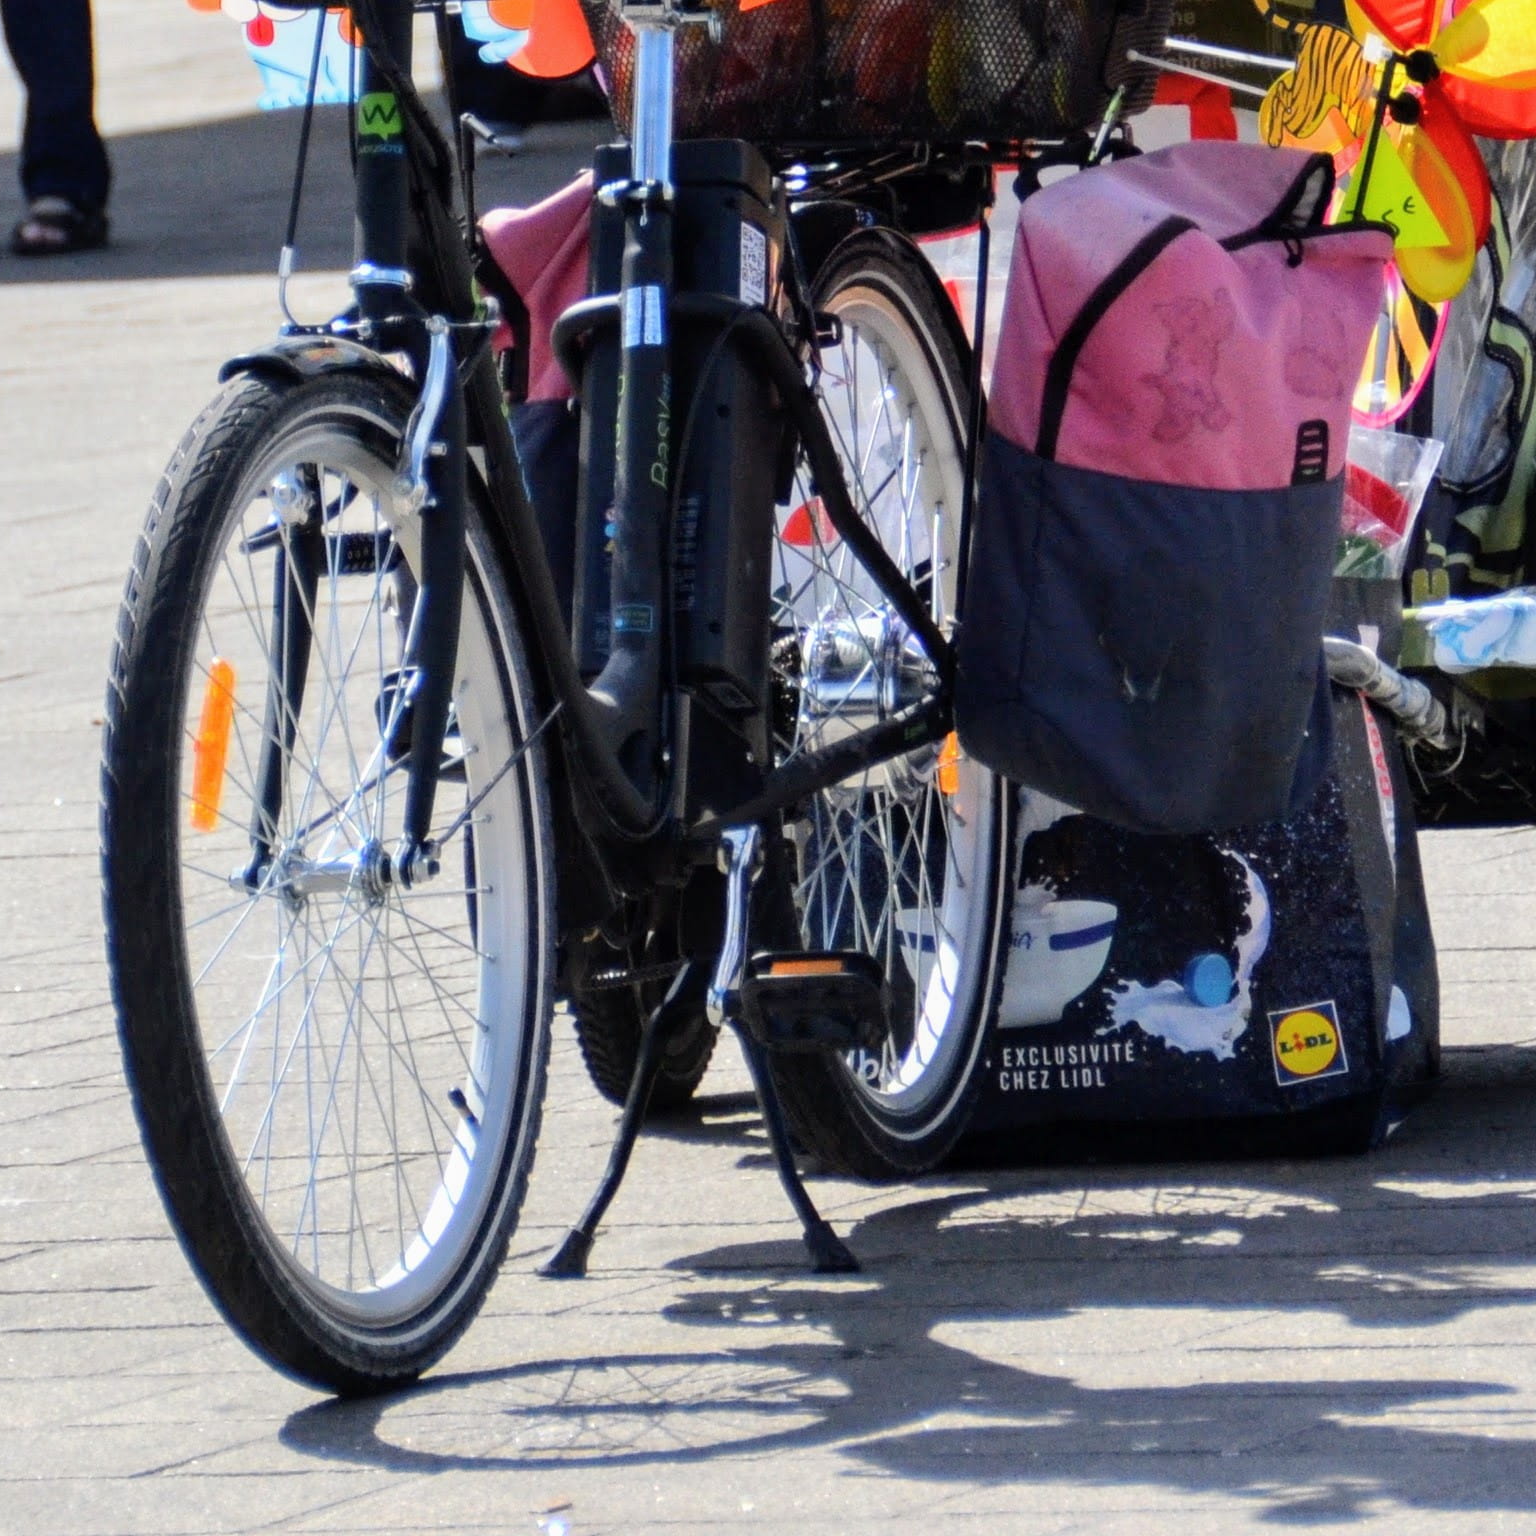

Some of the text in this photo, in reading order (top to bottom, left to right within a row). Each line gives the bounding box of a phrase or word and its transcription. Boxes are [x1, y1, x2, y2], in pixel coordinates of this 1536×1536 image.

[1002, 1039, 1136, 1067] EXCLUSIVITÉ
[999, 1067, 1106, 1092] CHEZ LIDL
